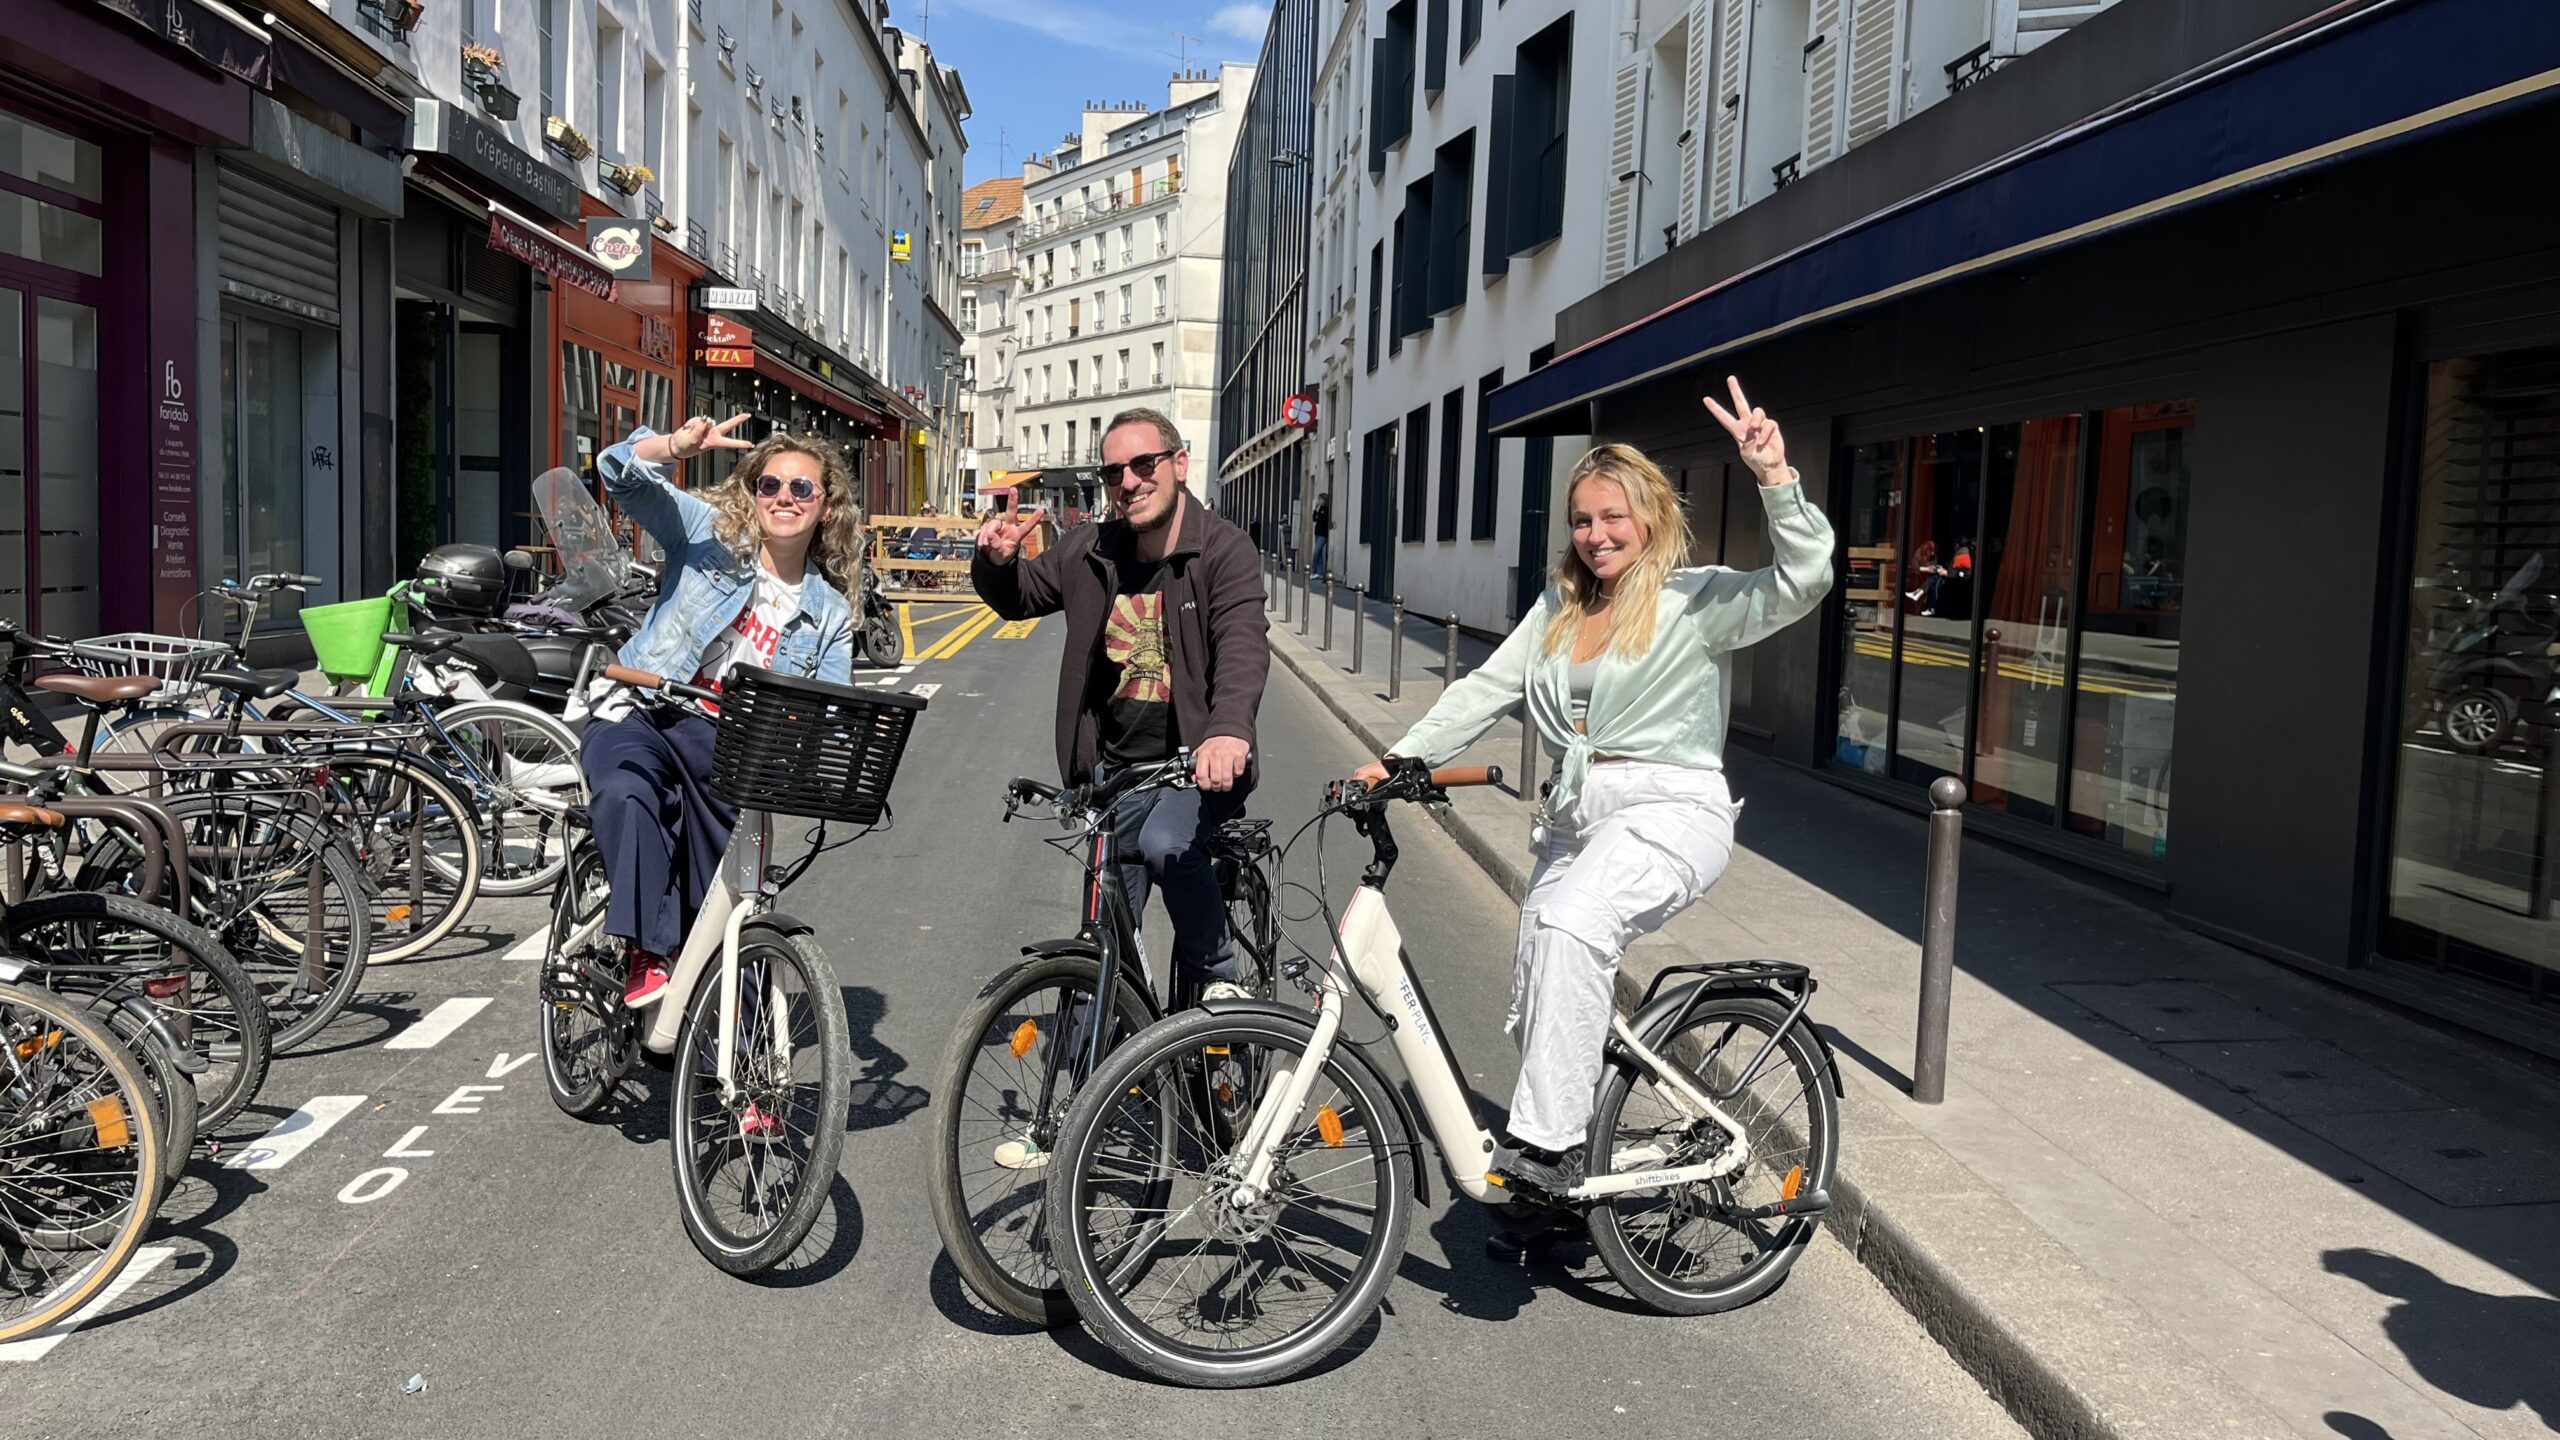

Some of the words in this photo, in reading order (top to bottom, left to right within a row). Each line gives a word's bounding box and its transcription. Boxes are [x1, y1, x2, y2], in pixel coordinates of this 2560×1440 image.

[475, 129, 523, 179] Crêperie
[525, 161, 562, 202] Bastille
[709, 318, 725, 328] Bar
[698, 331, 737, 344] Cocktails
[694, 348, 742, 363] PIZZA
[167, 540, 184, 551] Vente
